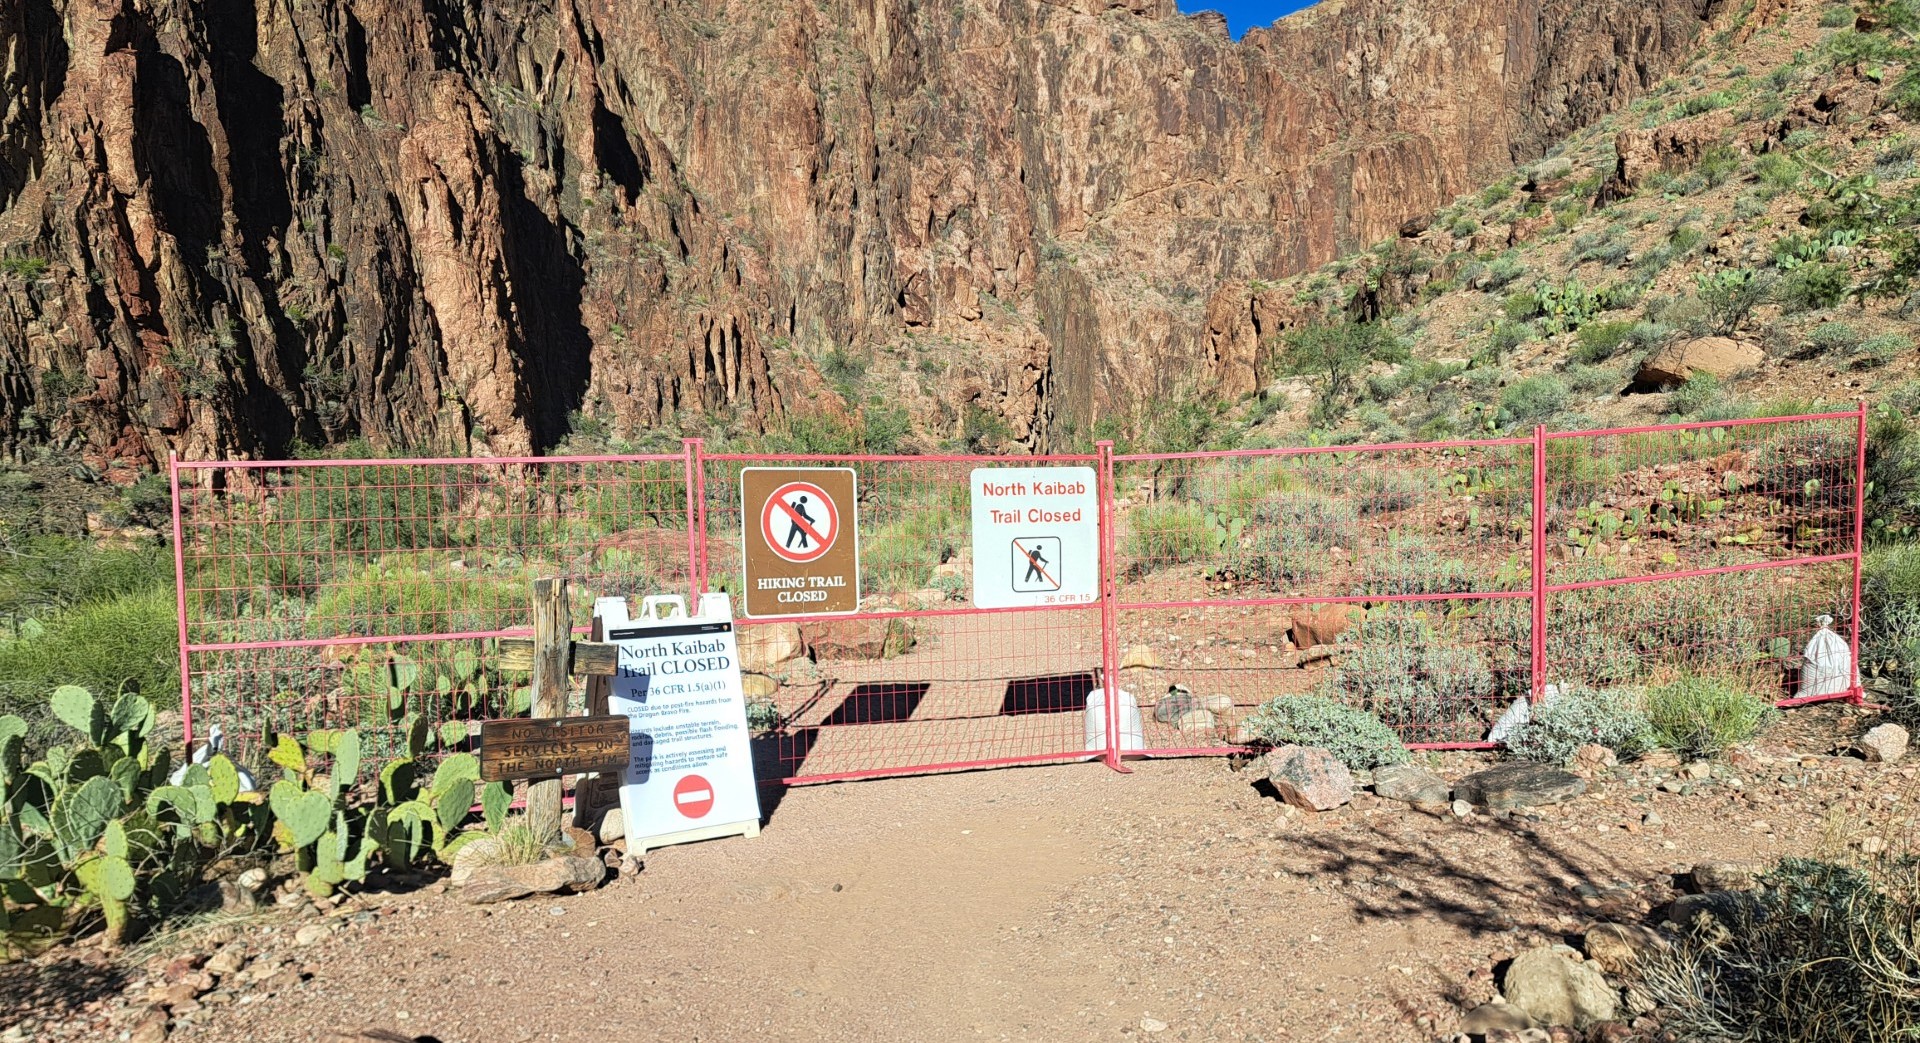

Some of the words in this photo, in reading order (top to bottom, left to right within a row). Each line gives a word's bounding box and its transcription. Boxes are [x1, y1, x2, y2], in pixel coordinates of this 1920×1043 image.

[983, 483, 1026, 496] North
[1033, 481, 1085, 495] Kaibab
[990, 509, 1020, 523] Trail
[1028, 508, 1080, 522] Closed
[758, 577, 805, 589] HIKING
[808, 576, 846, 587] TRAIL
[778, 591, 827, 602] CLOSED
[621, 644, 667, 659] North
[672, 639, 725, 655] Kaibab
[620, 662, 656, 678] Trail
[661, 656, 729, 674] CLOSED
[631, 688, 646, 697] Per
[650, 687, 660, 696] 36
[663, 684, 685, 694] CFR
[688, 681, 725, 692] 1.5(a)(1)
[671, 702, 694, 710] post-fire
[512, 730, 530, 738] NO
[541, 725, 603, 736] VISITOR
[675, 728, 698, 736] possible
[504, 741, 577, 756] SERVICES
[596, 740, 613, 750] ON
[499, 762, 524, 772] THE
[536, 757, 580, 768] NORTH
[591, 755, 616, 765] RIM
